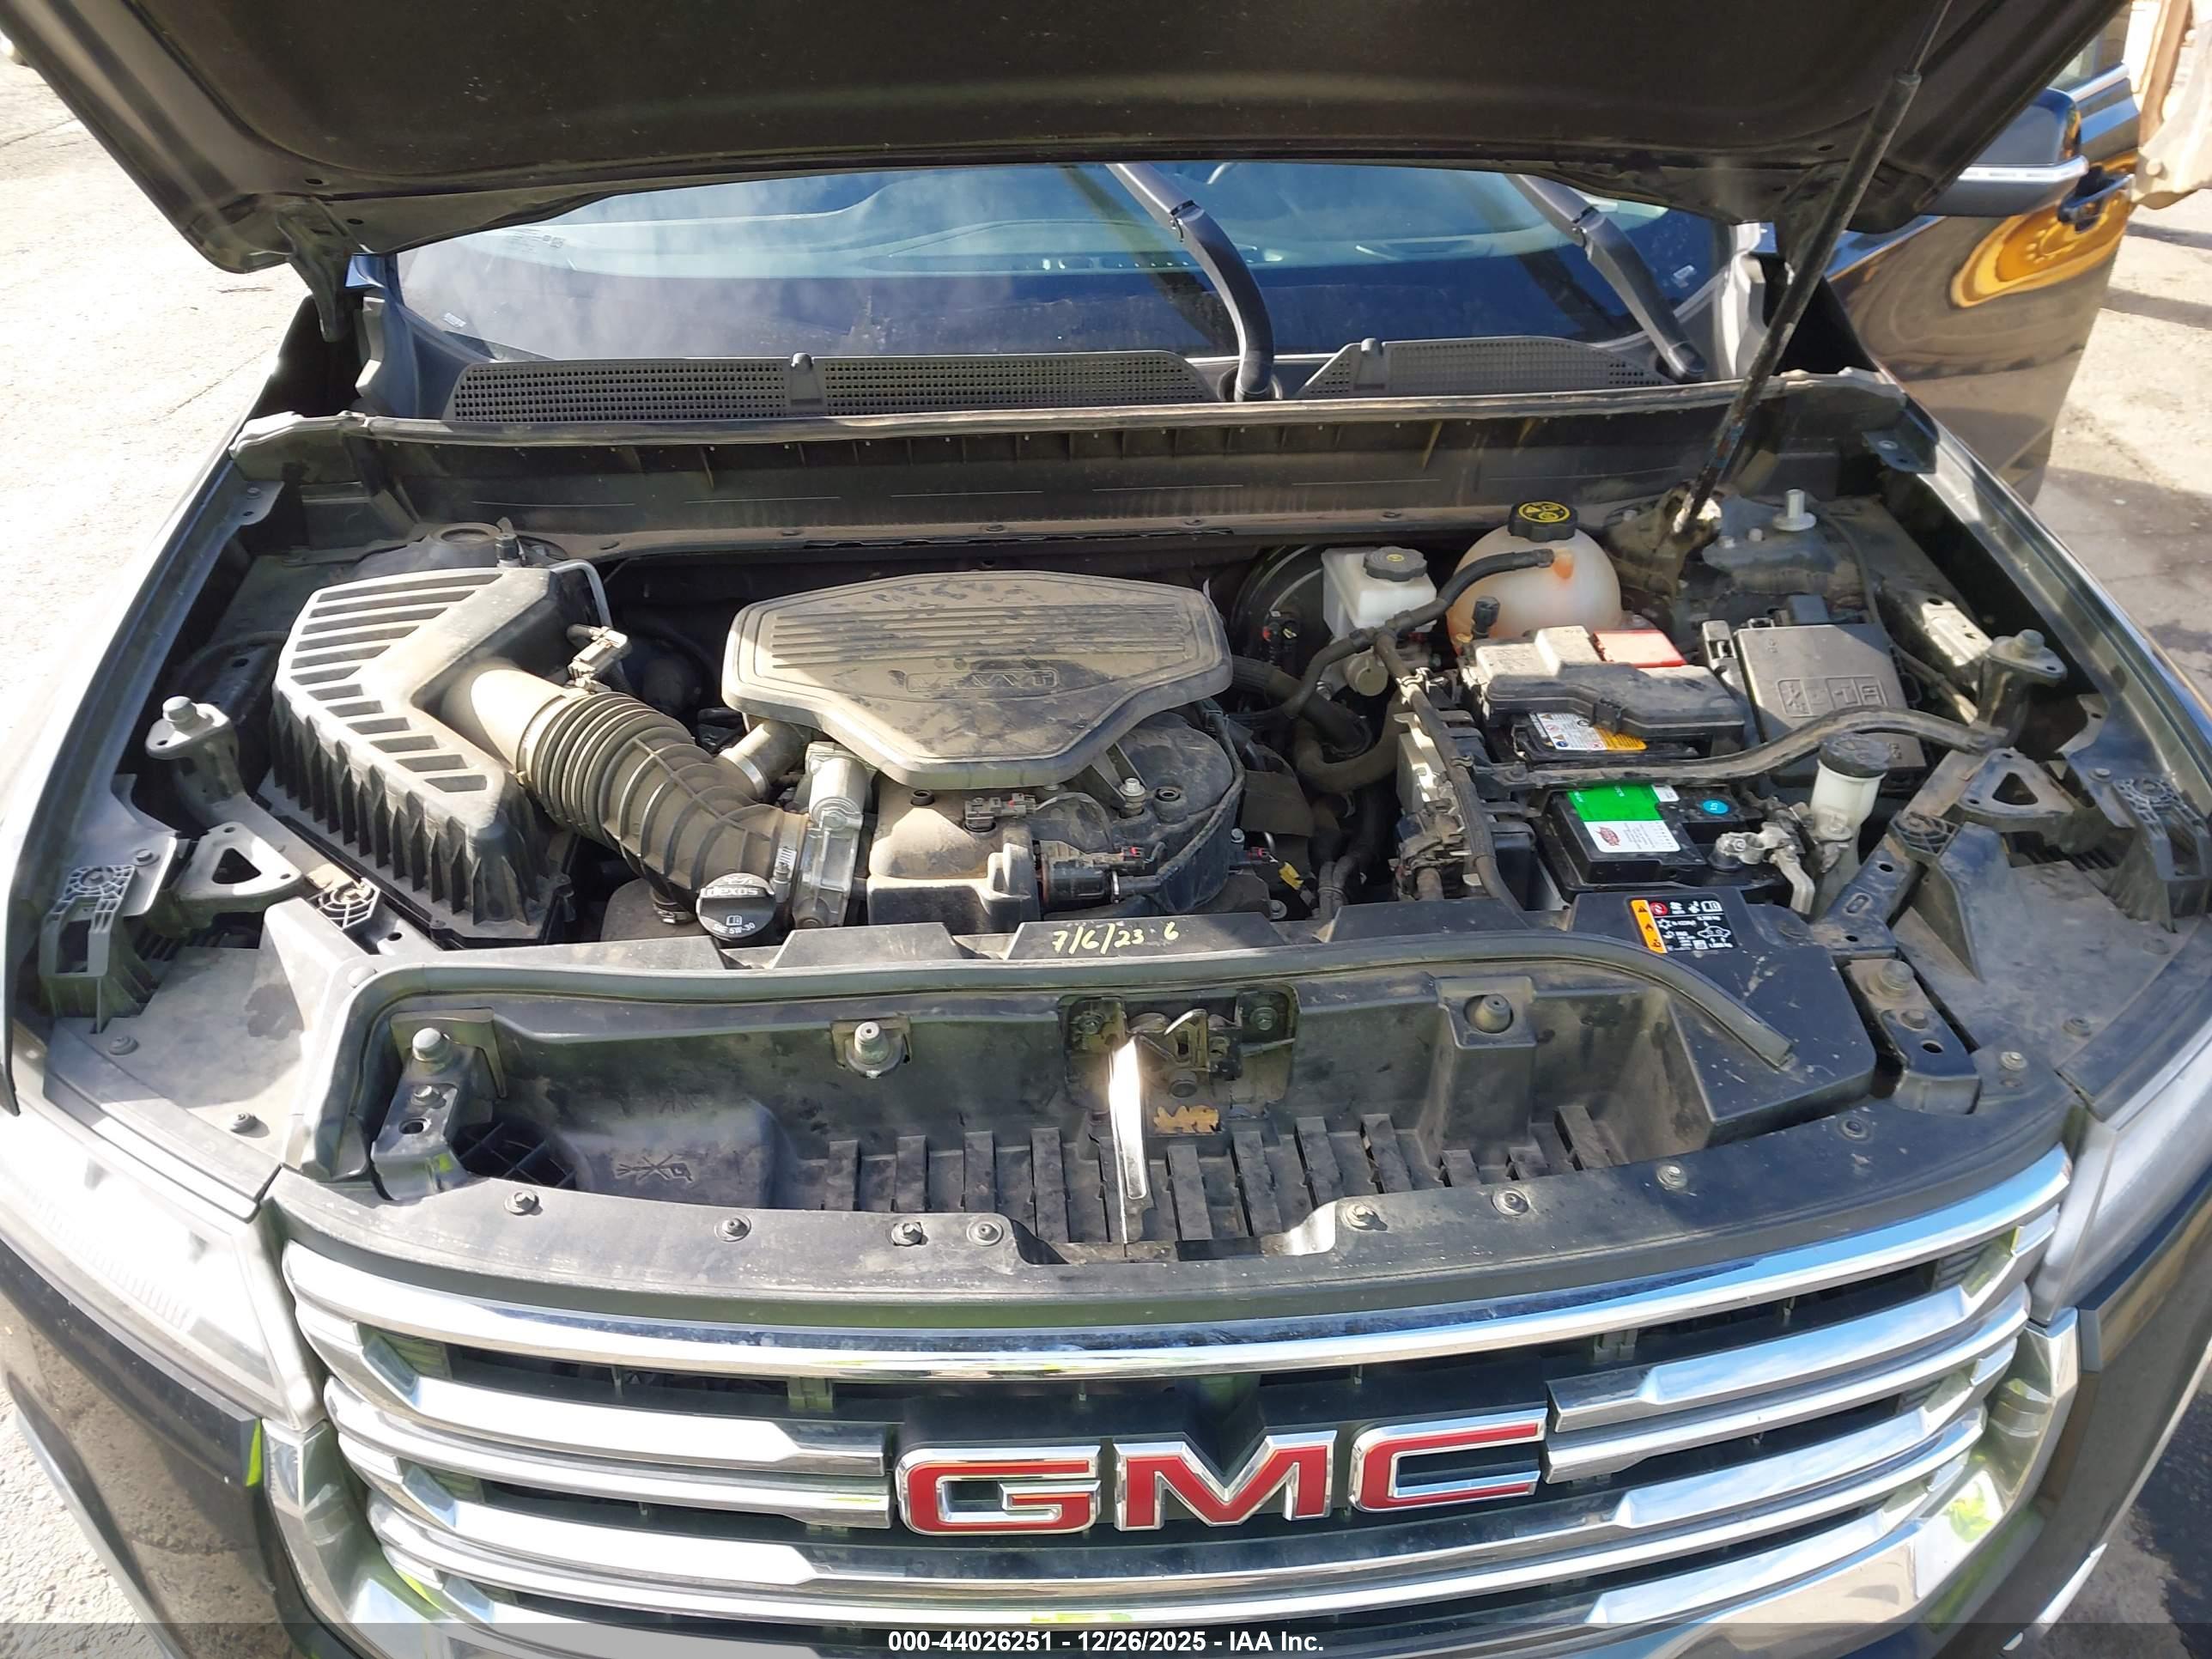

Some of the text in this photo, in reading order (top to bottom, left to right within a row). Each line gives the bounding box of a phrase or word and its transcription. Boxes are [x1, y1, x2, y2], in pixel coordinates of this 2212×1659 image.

[706, 885, 759, 896] dexos
[1052, 922, 1145, 955] 7/6/23
[895, 1407, 1547, 1535] GMC
